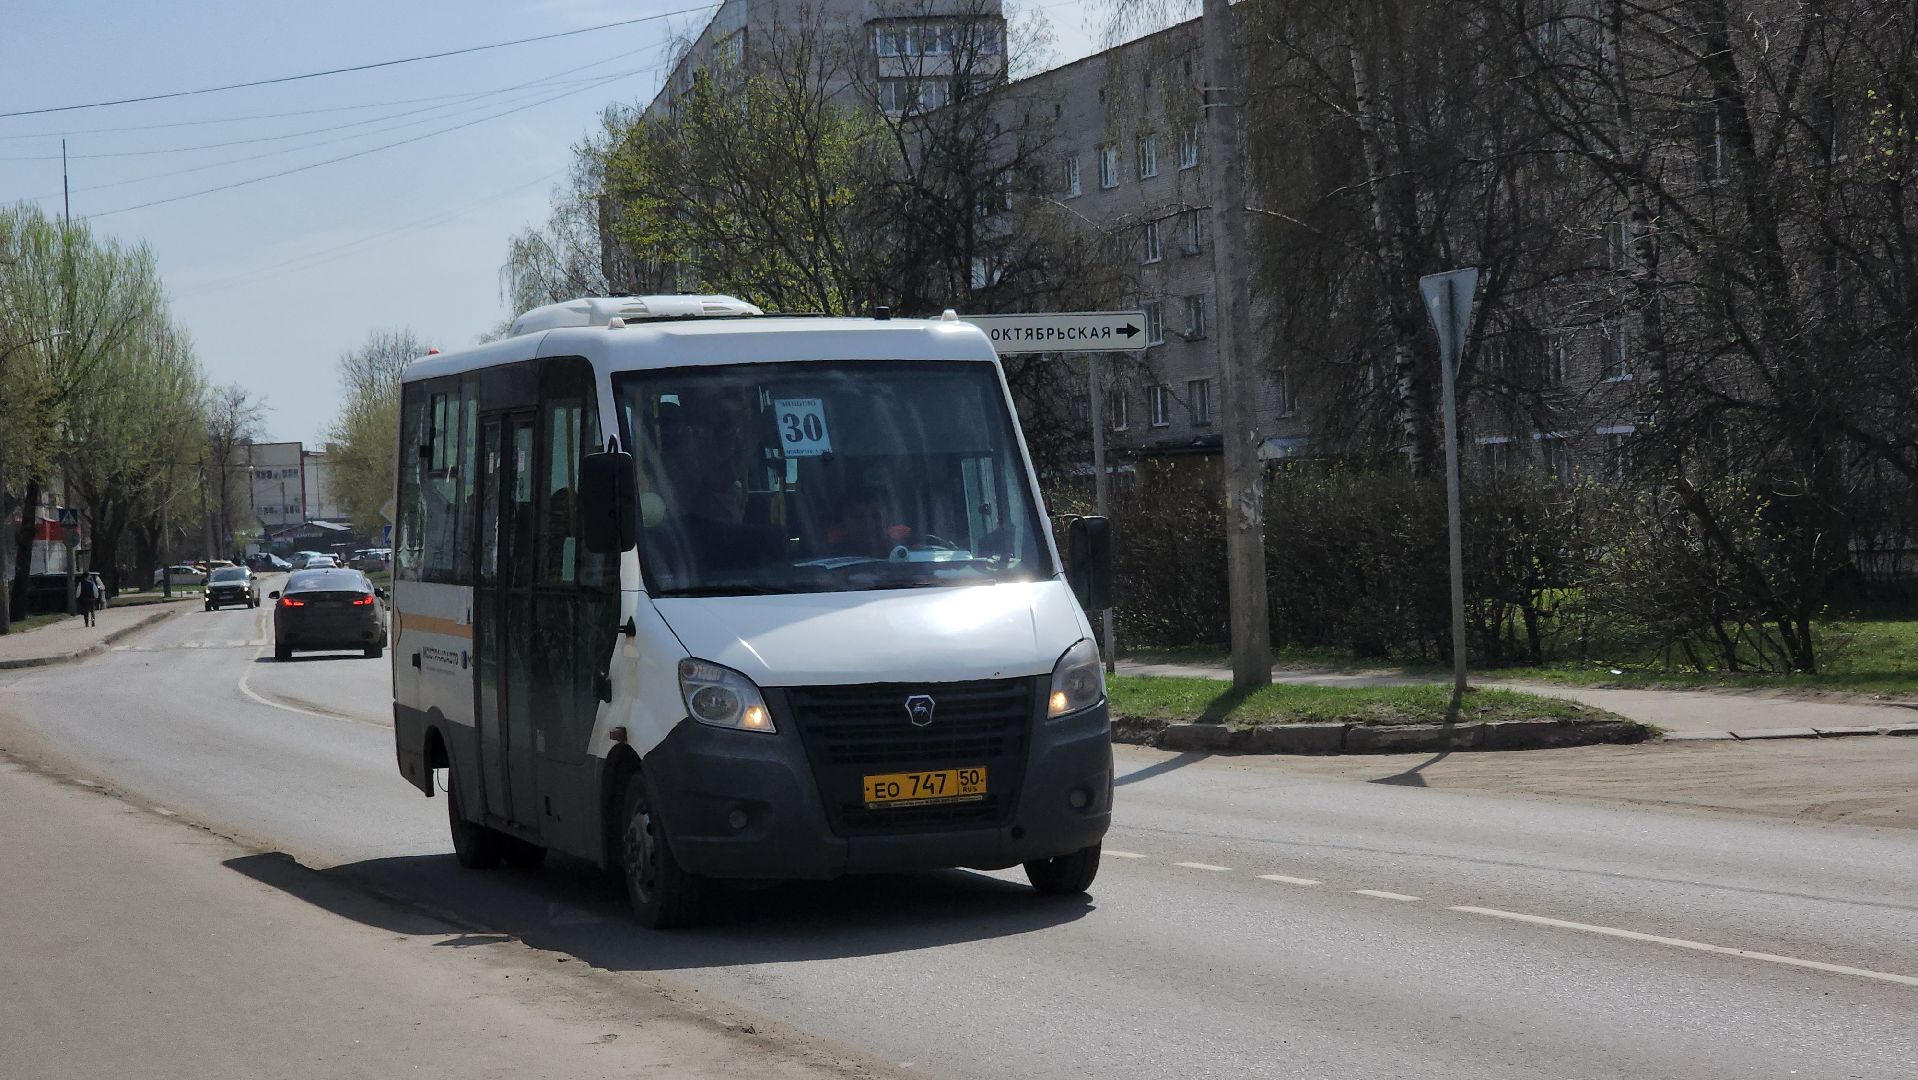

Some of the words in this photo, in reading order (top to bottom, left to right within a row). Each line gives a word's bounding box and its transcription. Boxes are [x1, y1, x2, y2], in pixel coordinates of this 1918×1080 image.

[990, 326, 1111, 341] ОКТЯБРЬСКАЯ
[783, 413, 823, 442] 30
[909, 774, 947, 795] 747
[960, 770, 979, 785] 50
